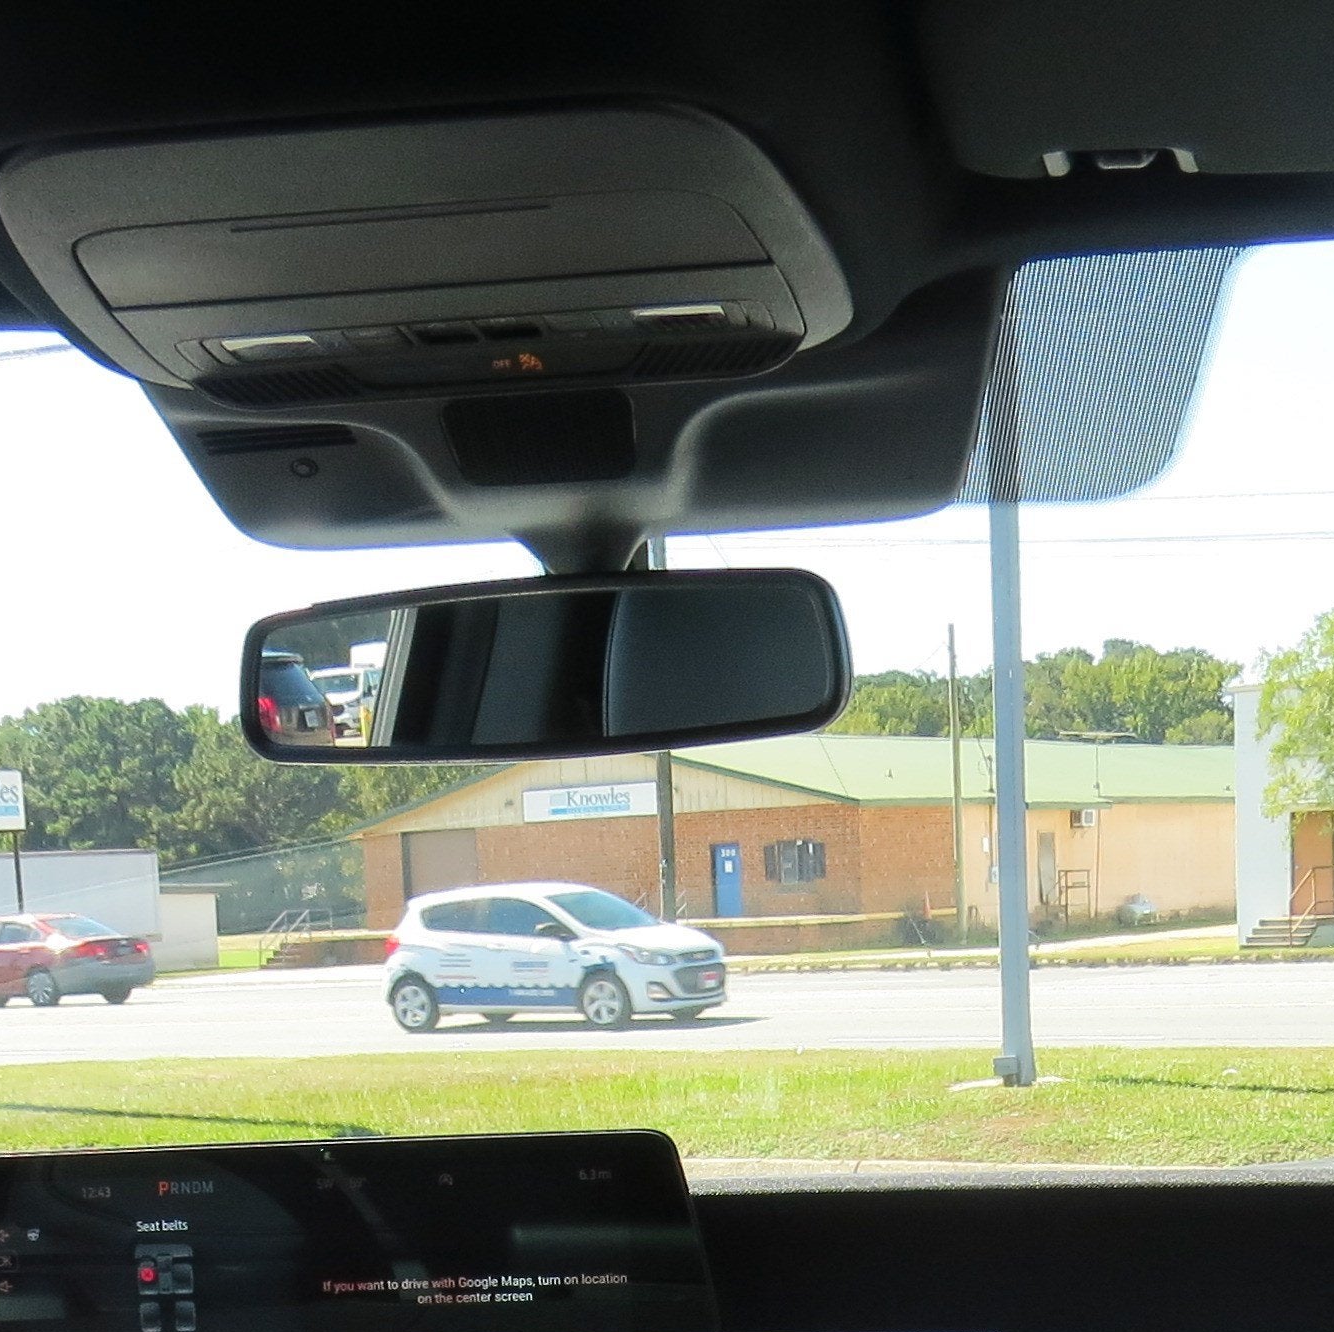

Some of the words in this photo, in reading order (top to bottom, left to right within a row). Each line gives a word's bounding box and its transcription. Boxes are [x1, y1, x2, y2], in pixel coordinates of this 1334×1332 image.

[566, 786, 631, 807] Knowles
[81, 1186, 112, 1198] 12:43
[136, 1220, 160, 1232] Seat
[162, 1219, 189, 1231] belts
[322, 1280, 331, 1292] If
[334, 1281, 355, 1294] you
[357, 1280, 385, 1291] want
[387, 1279, 399, 1291] to
[401, 1278, 429, 1290] drive
[431, 1277, 456, 1289] with
[458, 1276, 499, 1290] Google
[501, 1275, 536, 1289] Maps,
[538, 1275, 561, 1286] turn
[564, 1276, 579, 1285] on
[581, 1273, 628, 1285] location
[417, 1294, 432, 1305] on
[435, 1293, 453, 1304] the
[456, 1292, 492, 1304] center
[494, 1292, 534, 1303] screen
